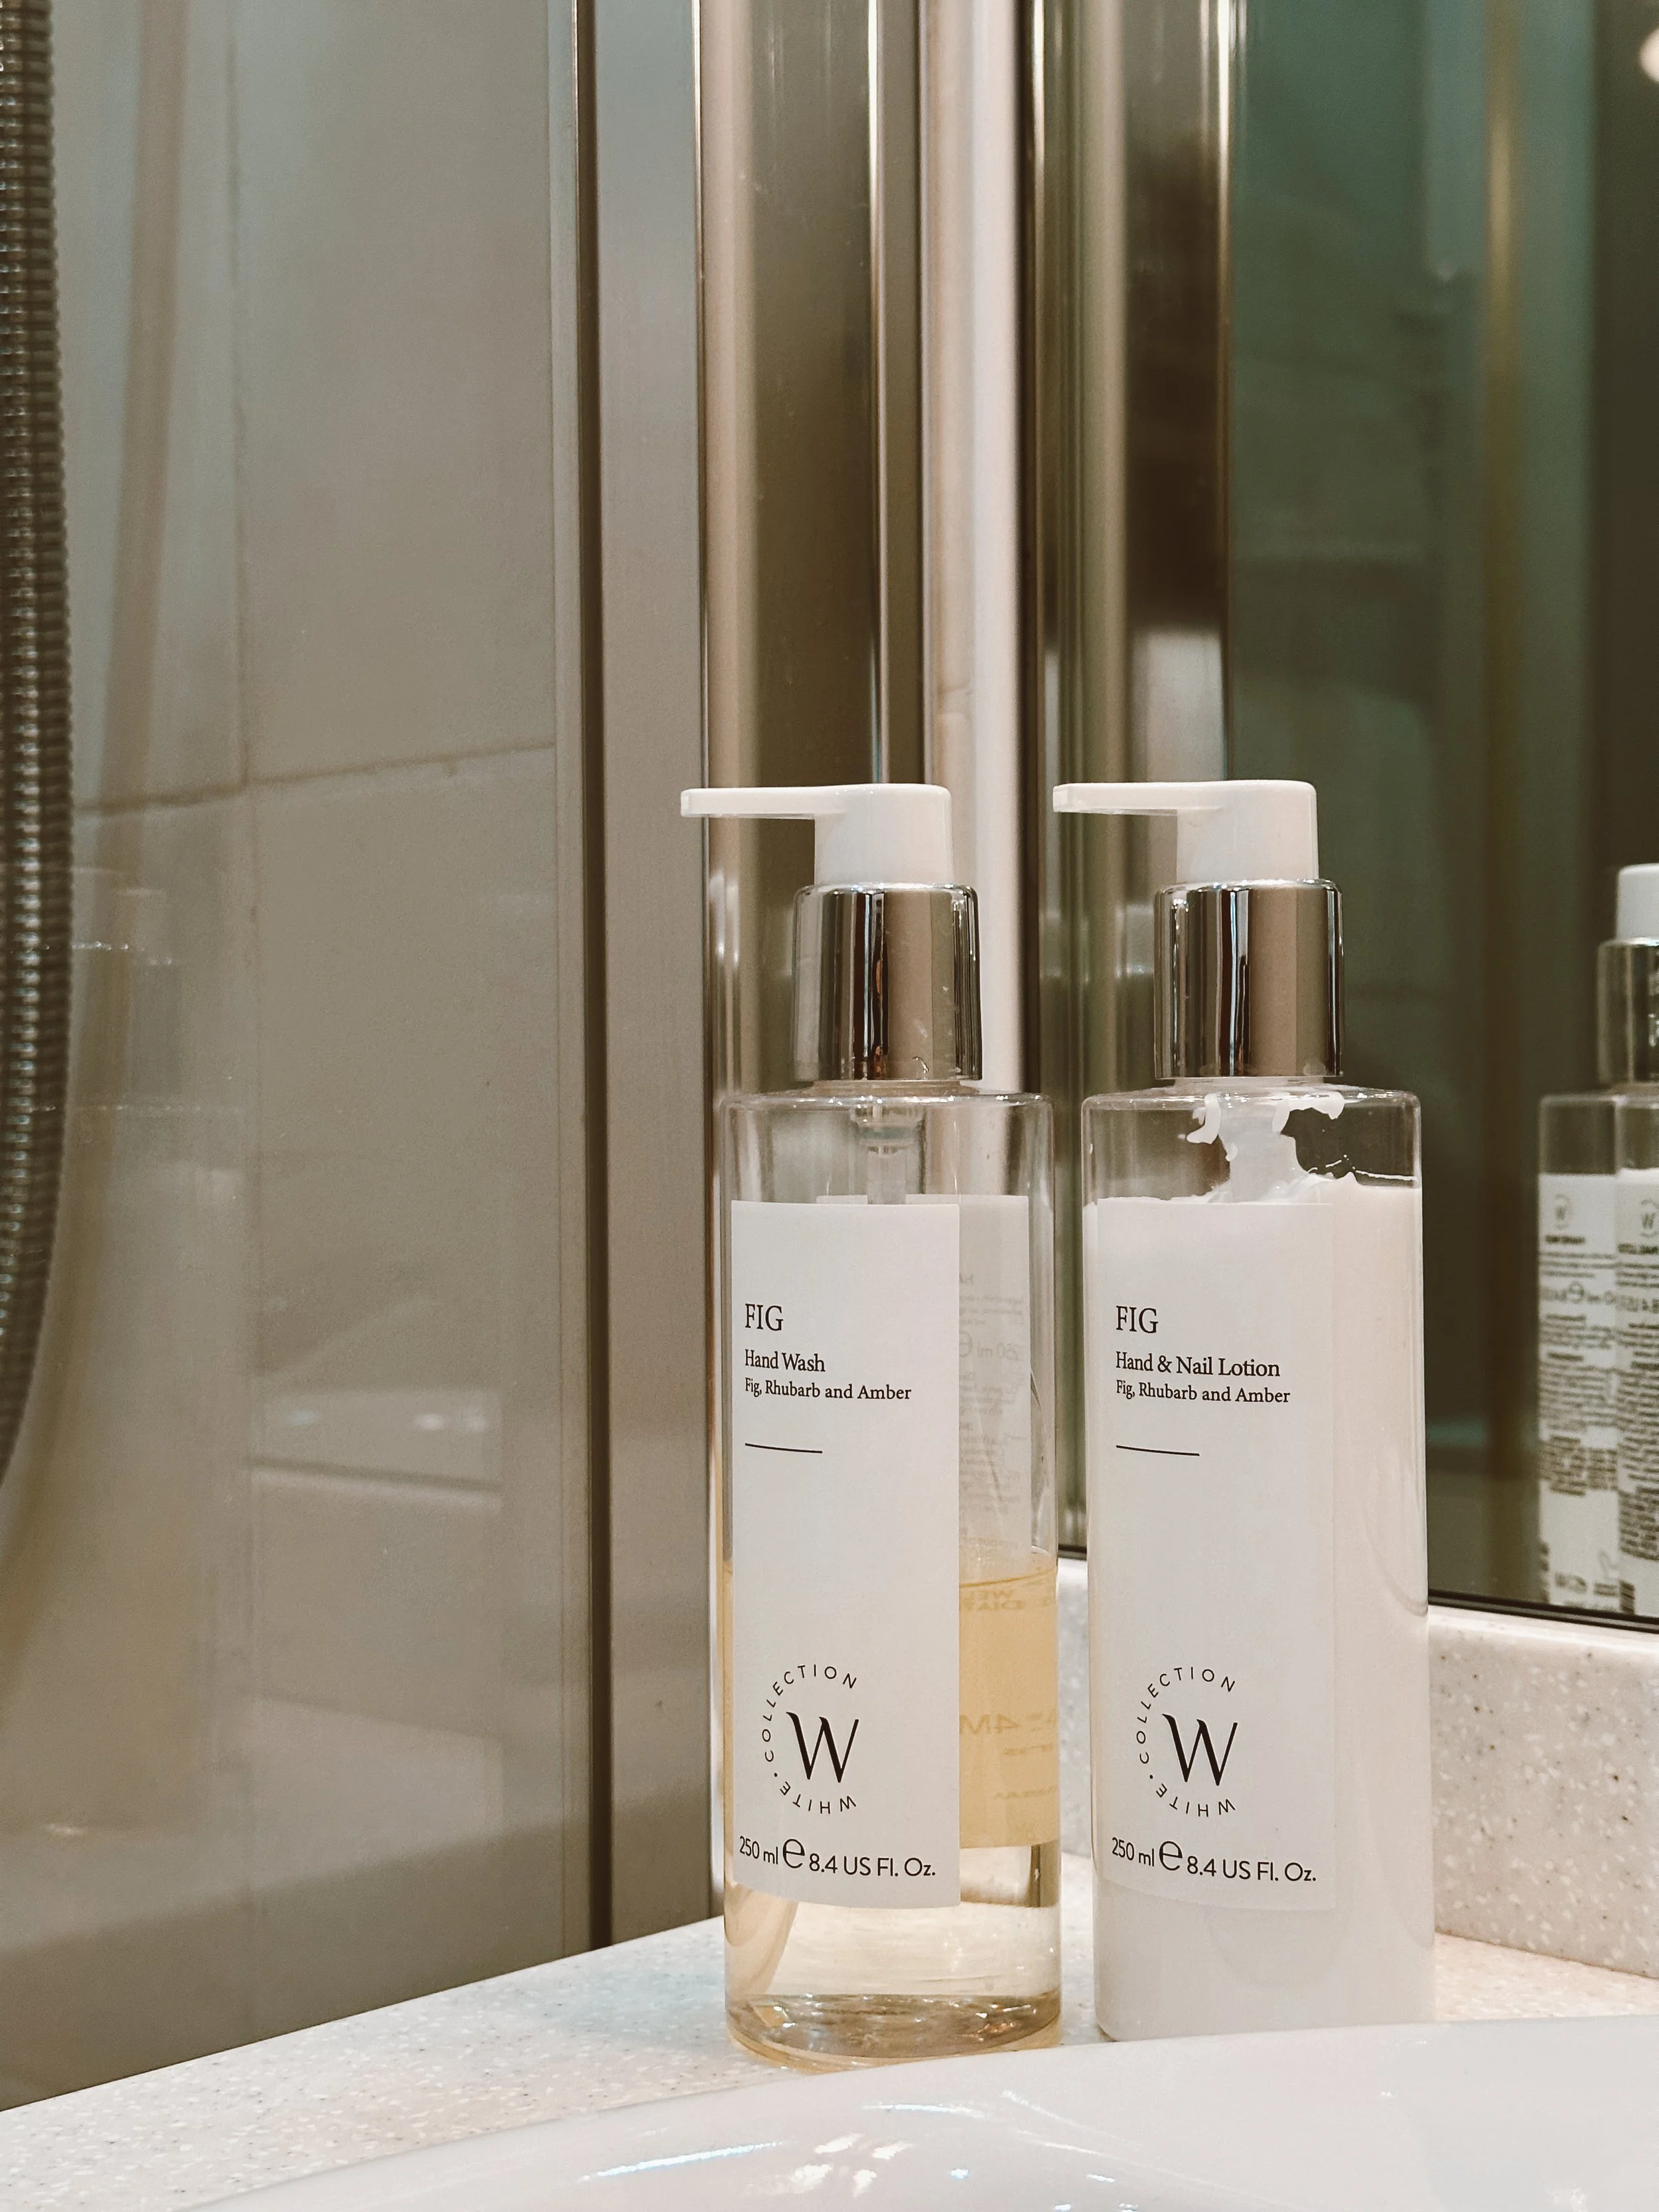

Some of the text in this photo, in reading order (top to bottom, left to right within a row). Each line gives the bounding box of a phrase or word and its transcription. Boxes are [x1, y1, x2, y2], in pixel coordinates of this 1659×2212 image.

[745, 1303, 784, 1331] FIG
[1116, 1305, 1159, 1334] FIG
[745, 1349, 826, 1372] Hand Wash
[1116, 1351, 1281, 1377] Hand & Nail Lotion
[745, 1377, 912, 1400] Fig, Rhubarb and Amber
[1116, 1379, 1291, 1403] Fig, Rhubarb and Amber
[761, 1664, 858, 1814] WHITE COLLECTION
[786, 1712, 859, 1783] W
[1136, 1666, 1236, 1818] WHITE COLLECTION
[1161, 1713, 1238, 1787] W
[739, 1835, 760, 1860] 250
[763, 1846, 778, 1865] ml
[809, 1852, 838, 1874] 8.4
[843, 1856, 871, 1876] US
[877, 1856, 899, 1878] Fl.
[904, 1857, 936, 1877] Oz.
[1112, 1836, 1135, 1861] 250
[1138, 1848, 1155, 1868] ml
[1187, 1855, 1217, 1878] 8.4
[1222, 1859, 1251, 1880] US
[1257, 1861, 1279, 1881] Fl.
[1284, 1862, 1317, 1882] Oz.
